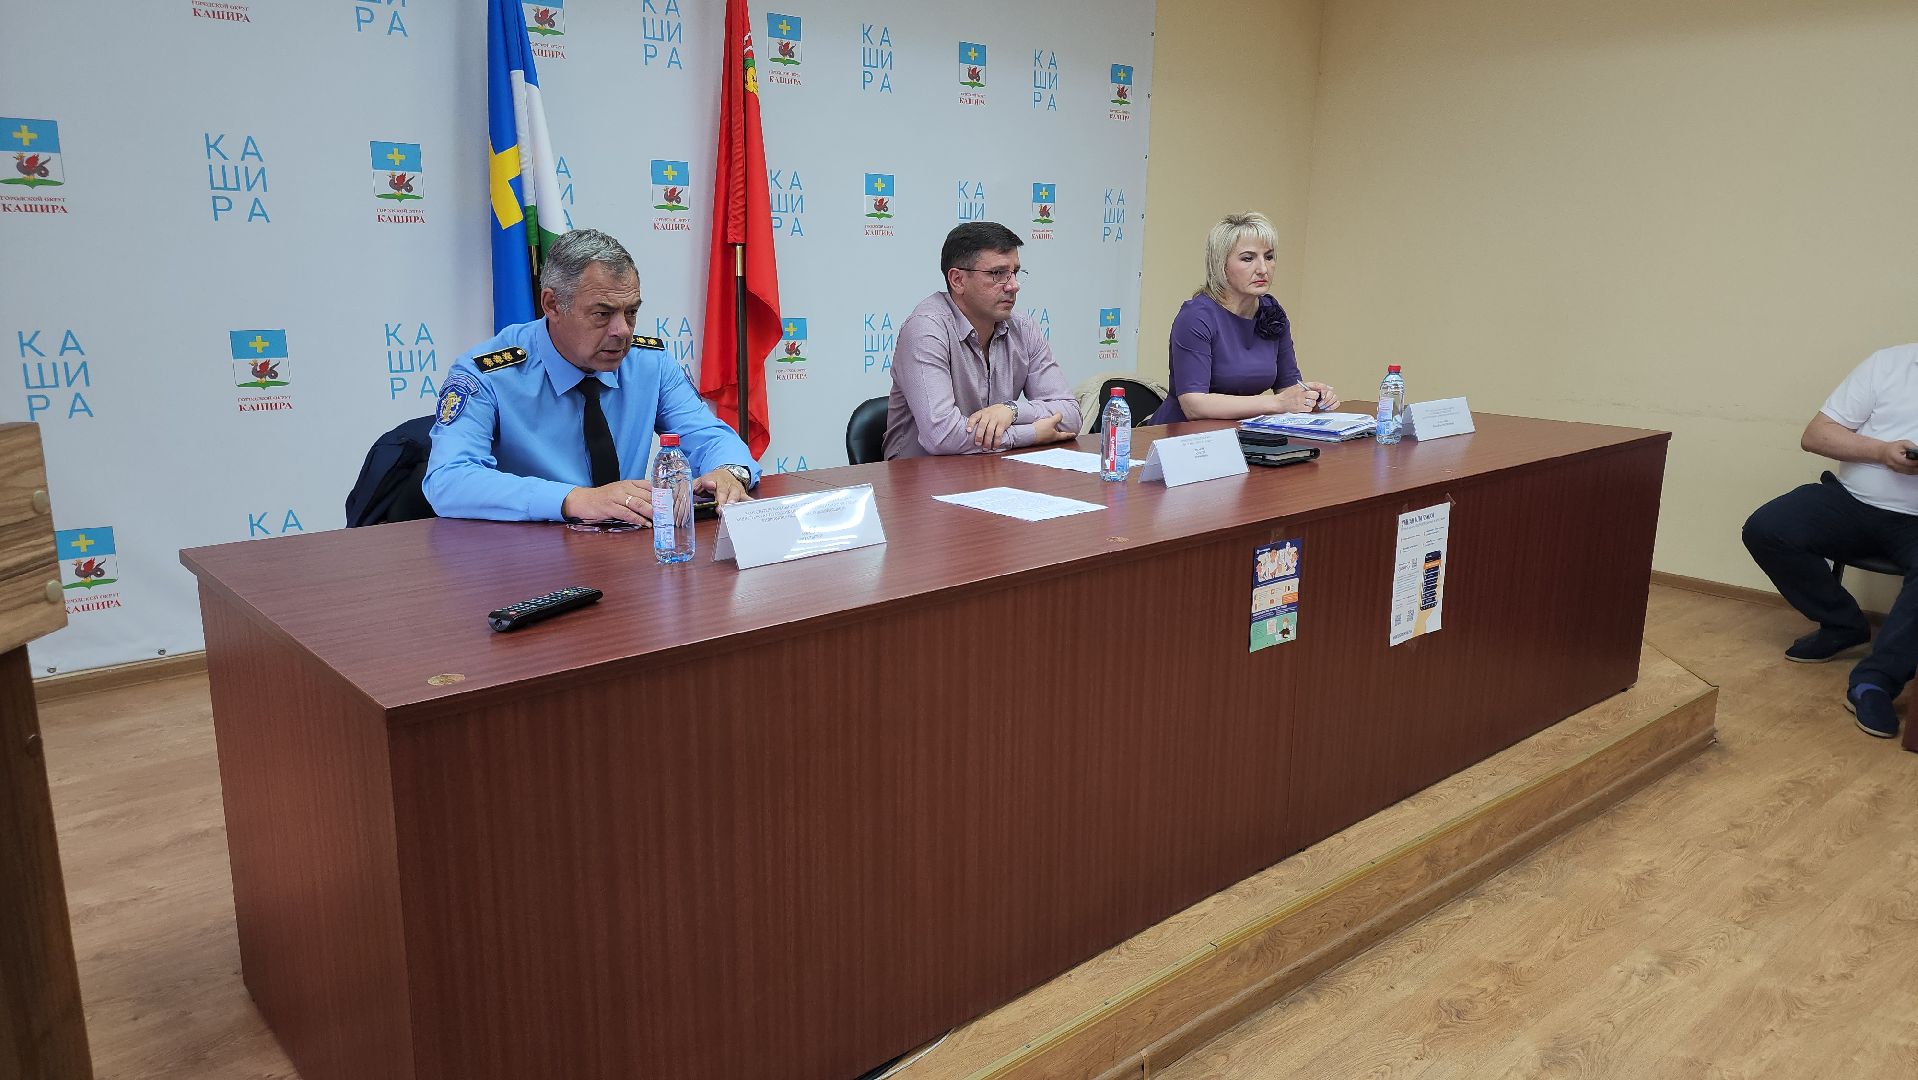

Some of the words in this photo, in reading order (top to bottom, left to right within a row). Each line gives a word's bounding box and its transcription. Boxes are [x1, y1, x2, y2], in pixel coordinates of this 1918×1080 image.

[192, 7, 251, 23] КАШИРА
[532, 48, 567, 60] АШИРА
[1, 203, 69, 214] КАШИРА
[376, 214, 426, 224] КАШИРА
[239, 401, 293, 412] КАШИРА
